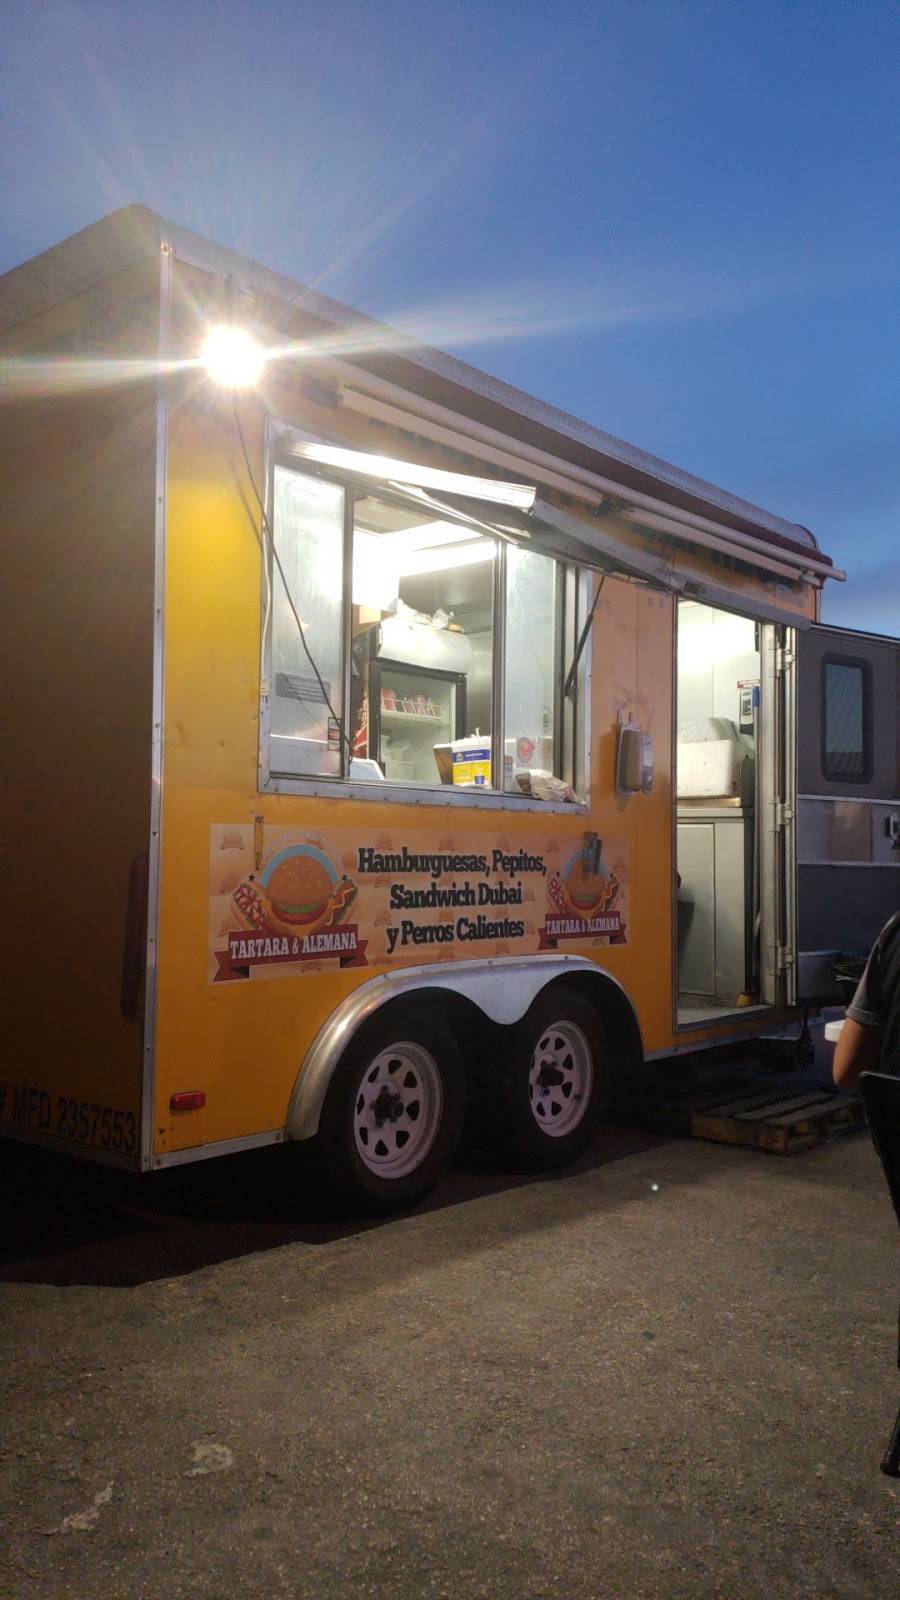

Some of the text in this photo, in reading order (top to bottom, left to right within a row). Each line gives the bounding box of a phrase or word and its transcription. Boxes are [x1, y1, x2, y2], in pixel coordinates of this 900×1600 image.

[358, 846, 546, 878] Hamburguesas, Pepitos,
[390, 881, 522, 909] Sandwich Dubai
[386, 915, 524, 954] y Perros Calientes
[546, 917, 620, 934] TARTARA & ALEMANA
[230, 933, 357, 959] TARTARA & ALEMANA
[12, 1087, 51, 1128] MFD
